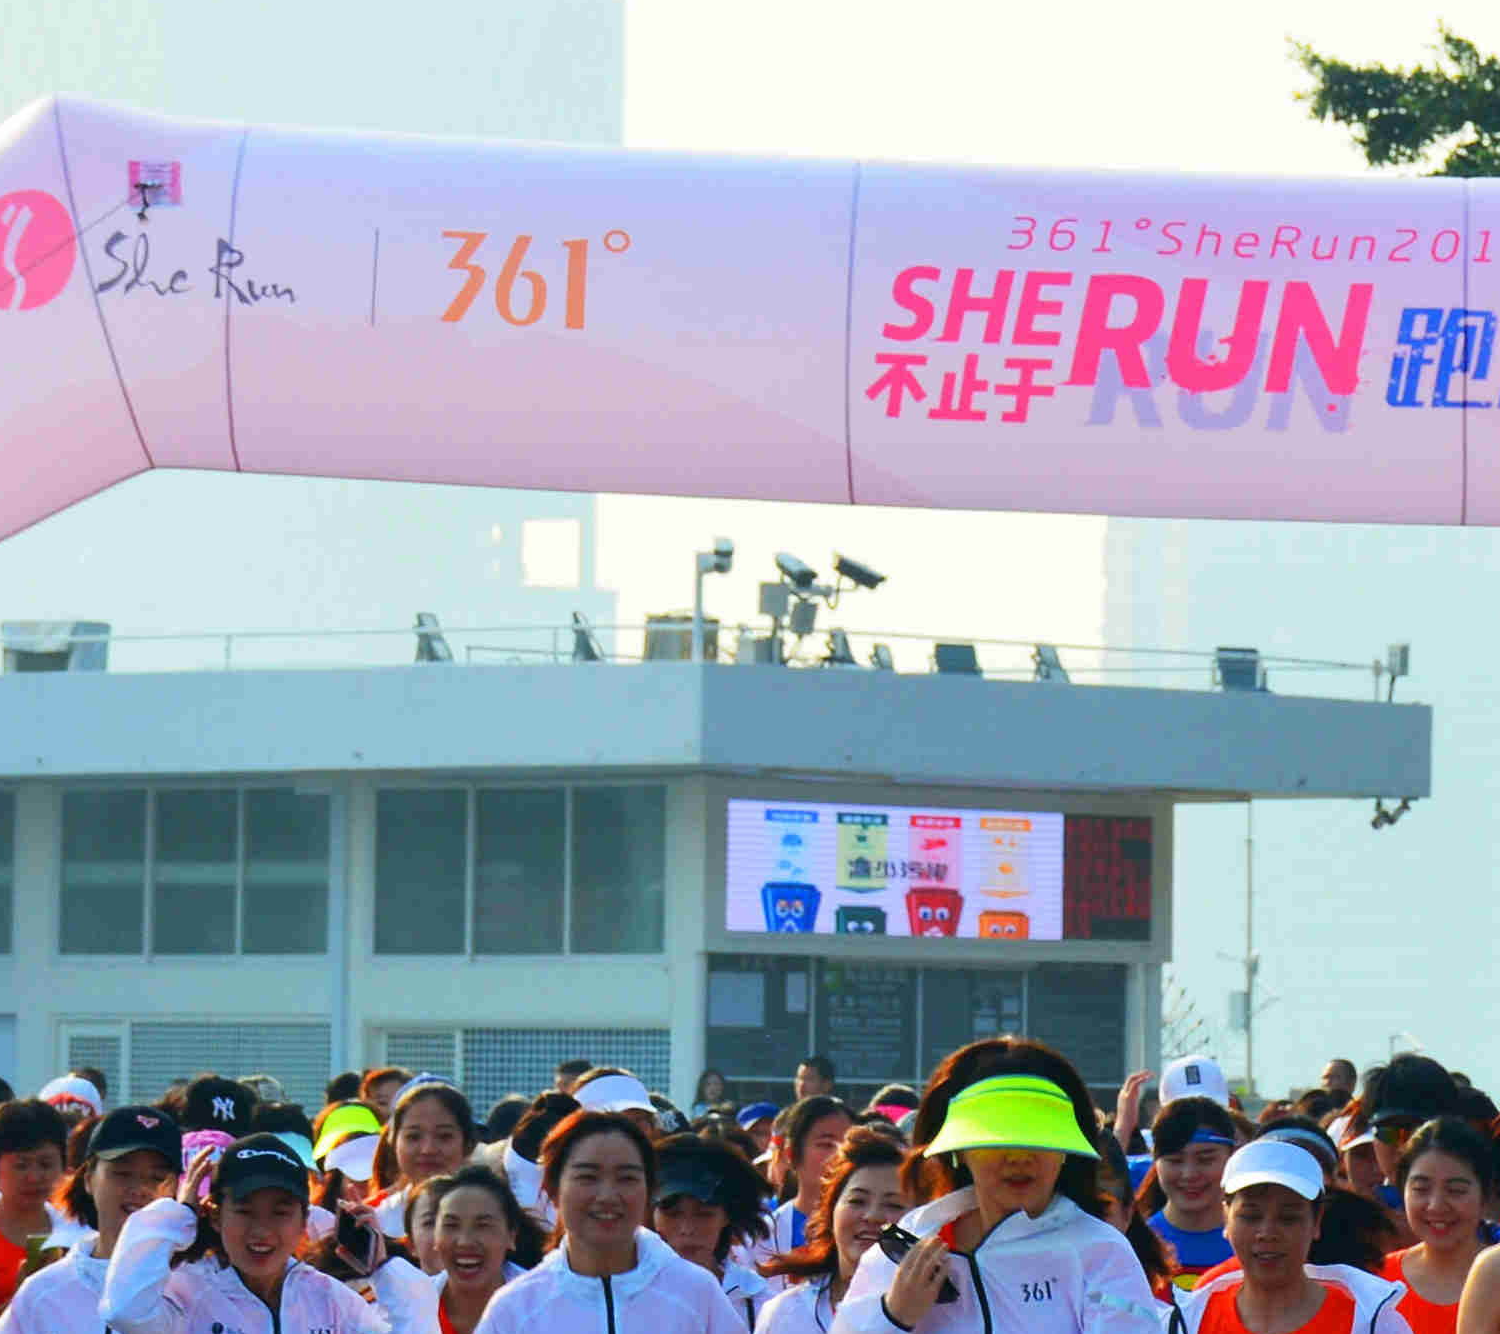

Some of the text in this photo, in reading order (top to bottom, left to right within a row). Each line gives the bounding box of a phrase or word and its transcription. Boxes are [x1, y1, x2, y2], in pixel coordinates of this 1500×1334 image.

[94, 231, 299, 307] She Run
[438, 228, 632, 331] 361°
[880, 265, 1374, 397] SHE RUN
[863, 351, 1057, 424] 不止于
